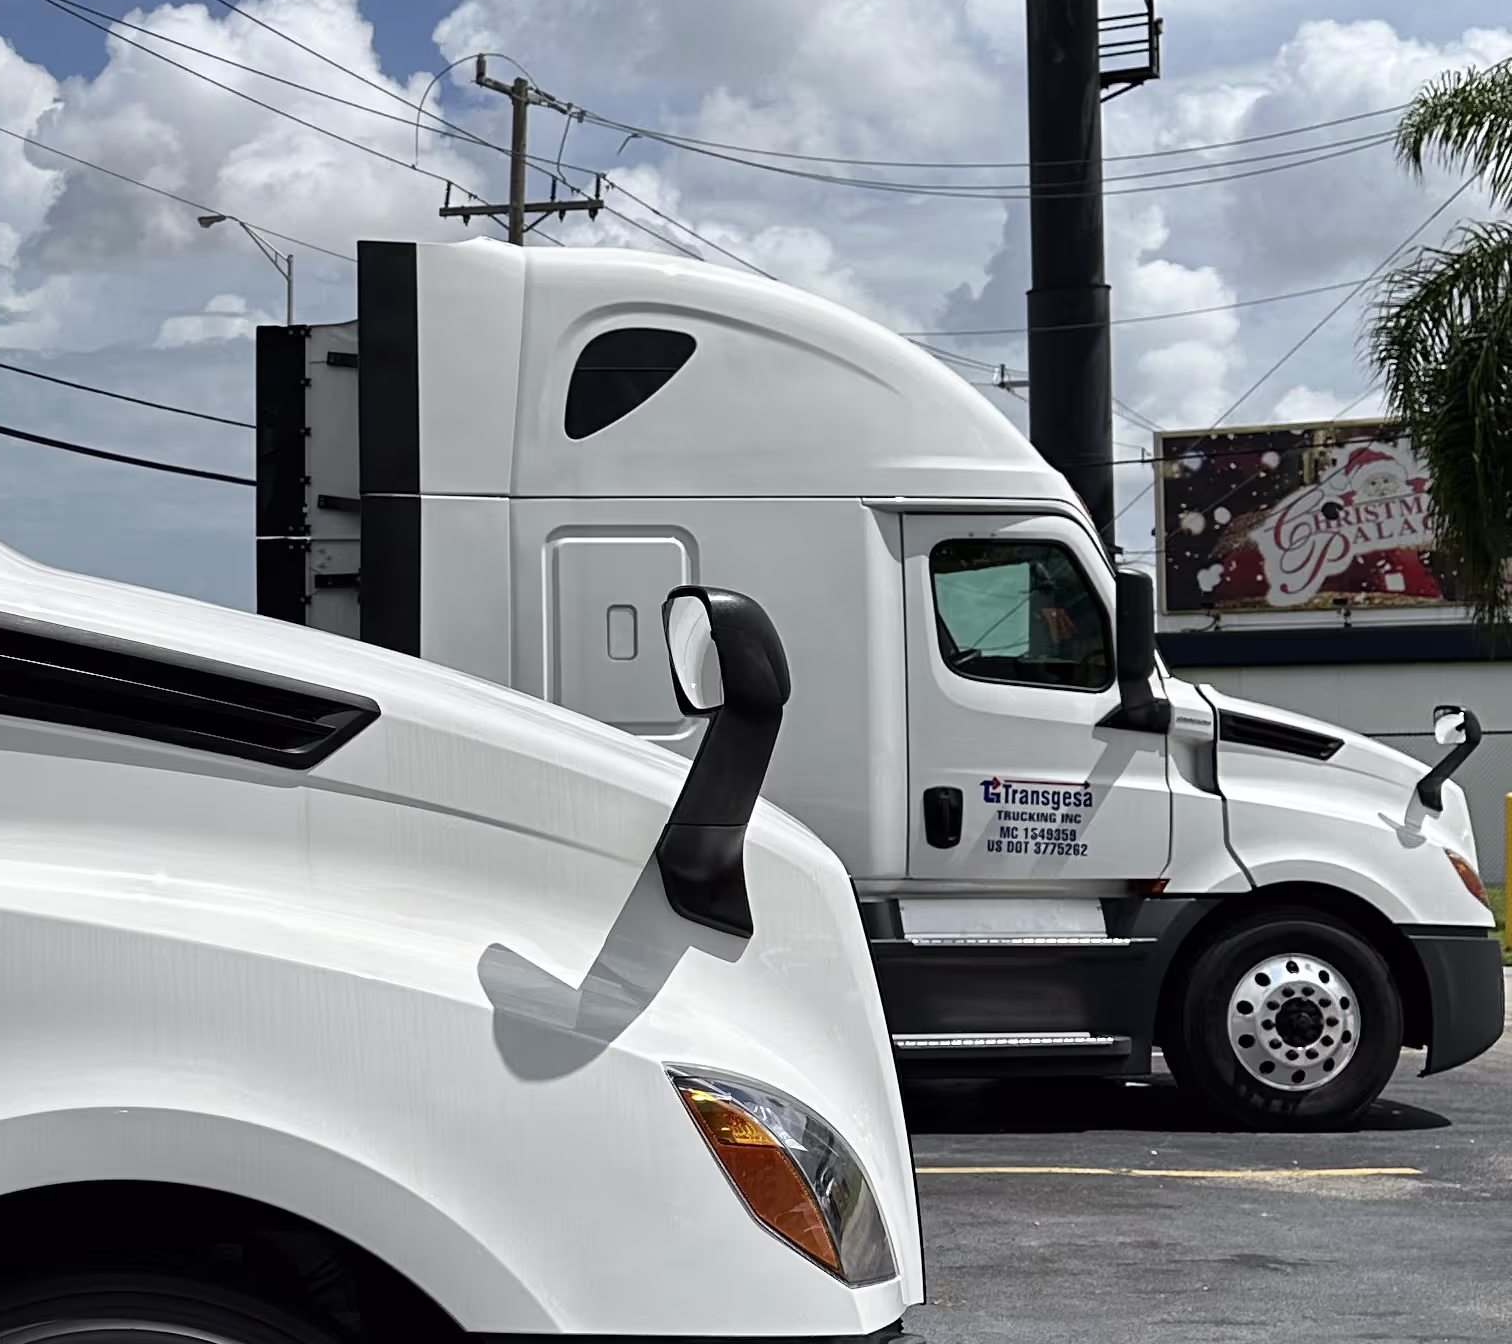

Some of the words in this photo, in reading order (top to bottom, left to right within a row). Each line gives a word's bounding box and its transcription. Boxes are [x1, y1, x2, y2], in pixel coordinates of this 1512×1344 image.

[1002, 784, 1093, 811] Transgesa
[996, 810, 1057, 824] TRUCKING
[1061, 813, 1082, 824] INC
[999, 826, 1019, 840] MC
[987, 840, 1003, 853] US
[1006, 841, 1030, 854] DOT
